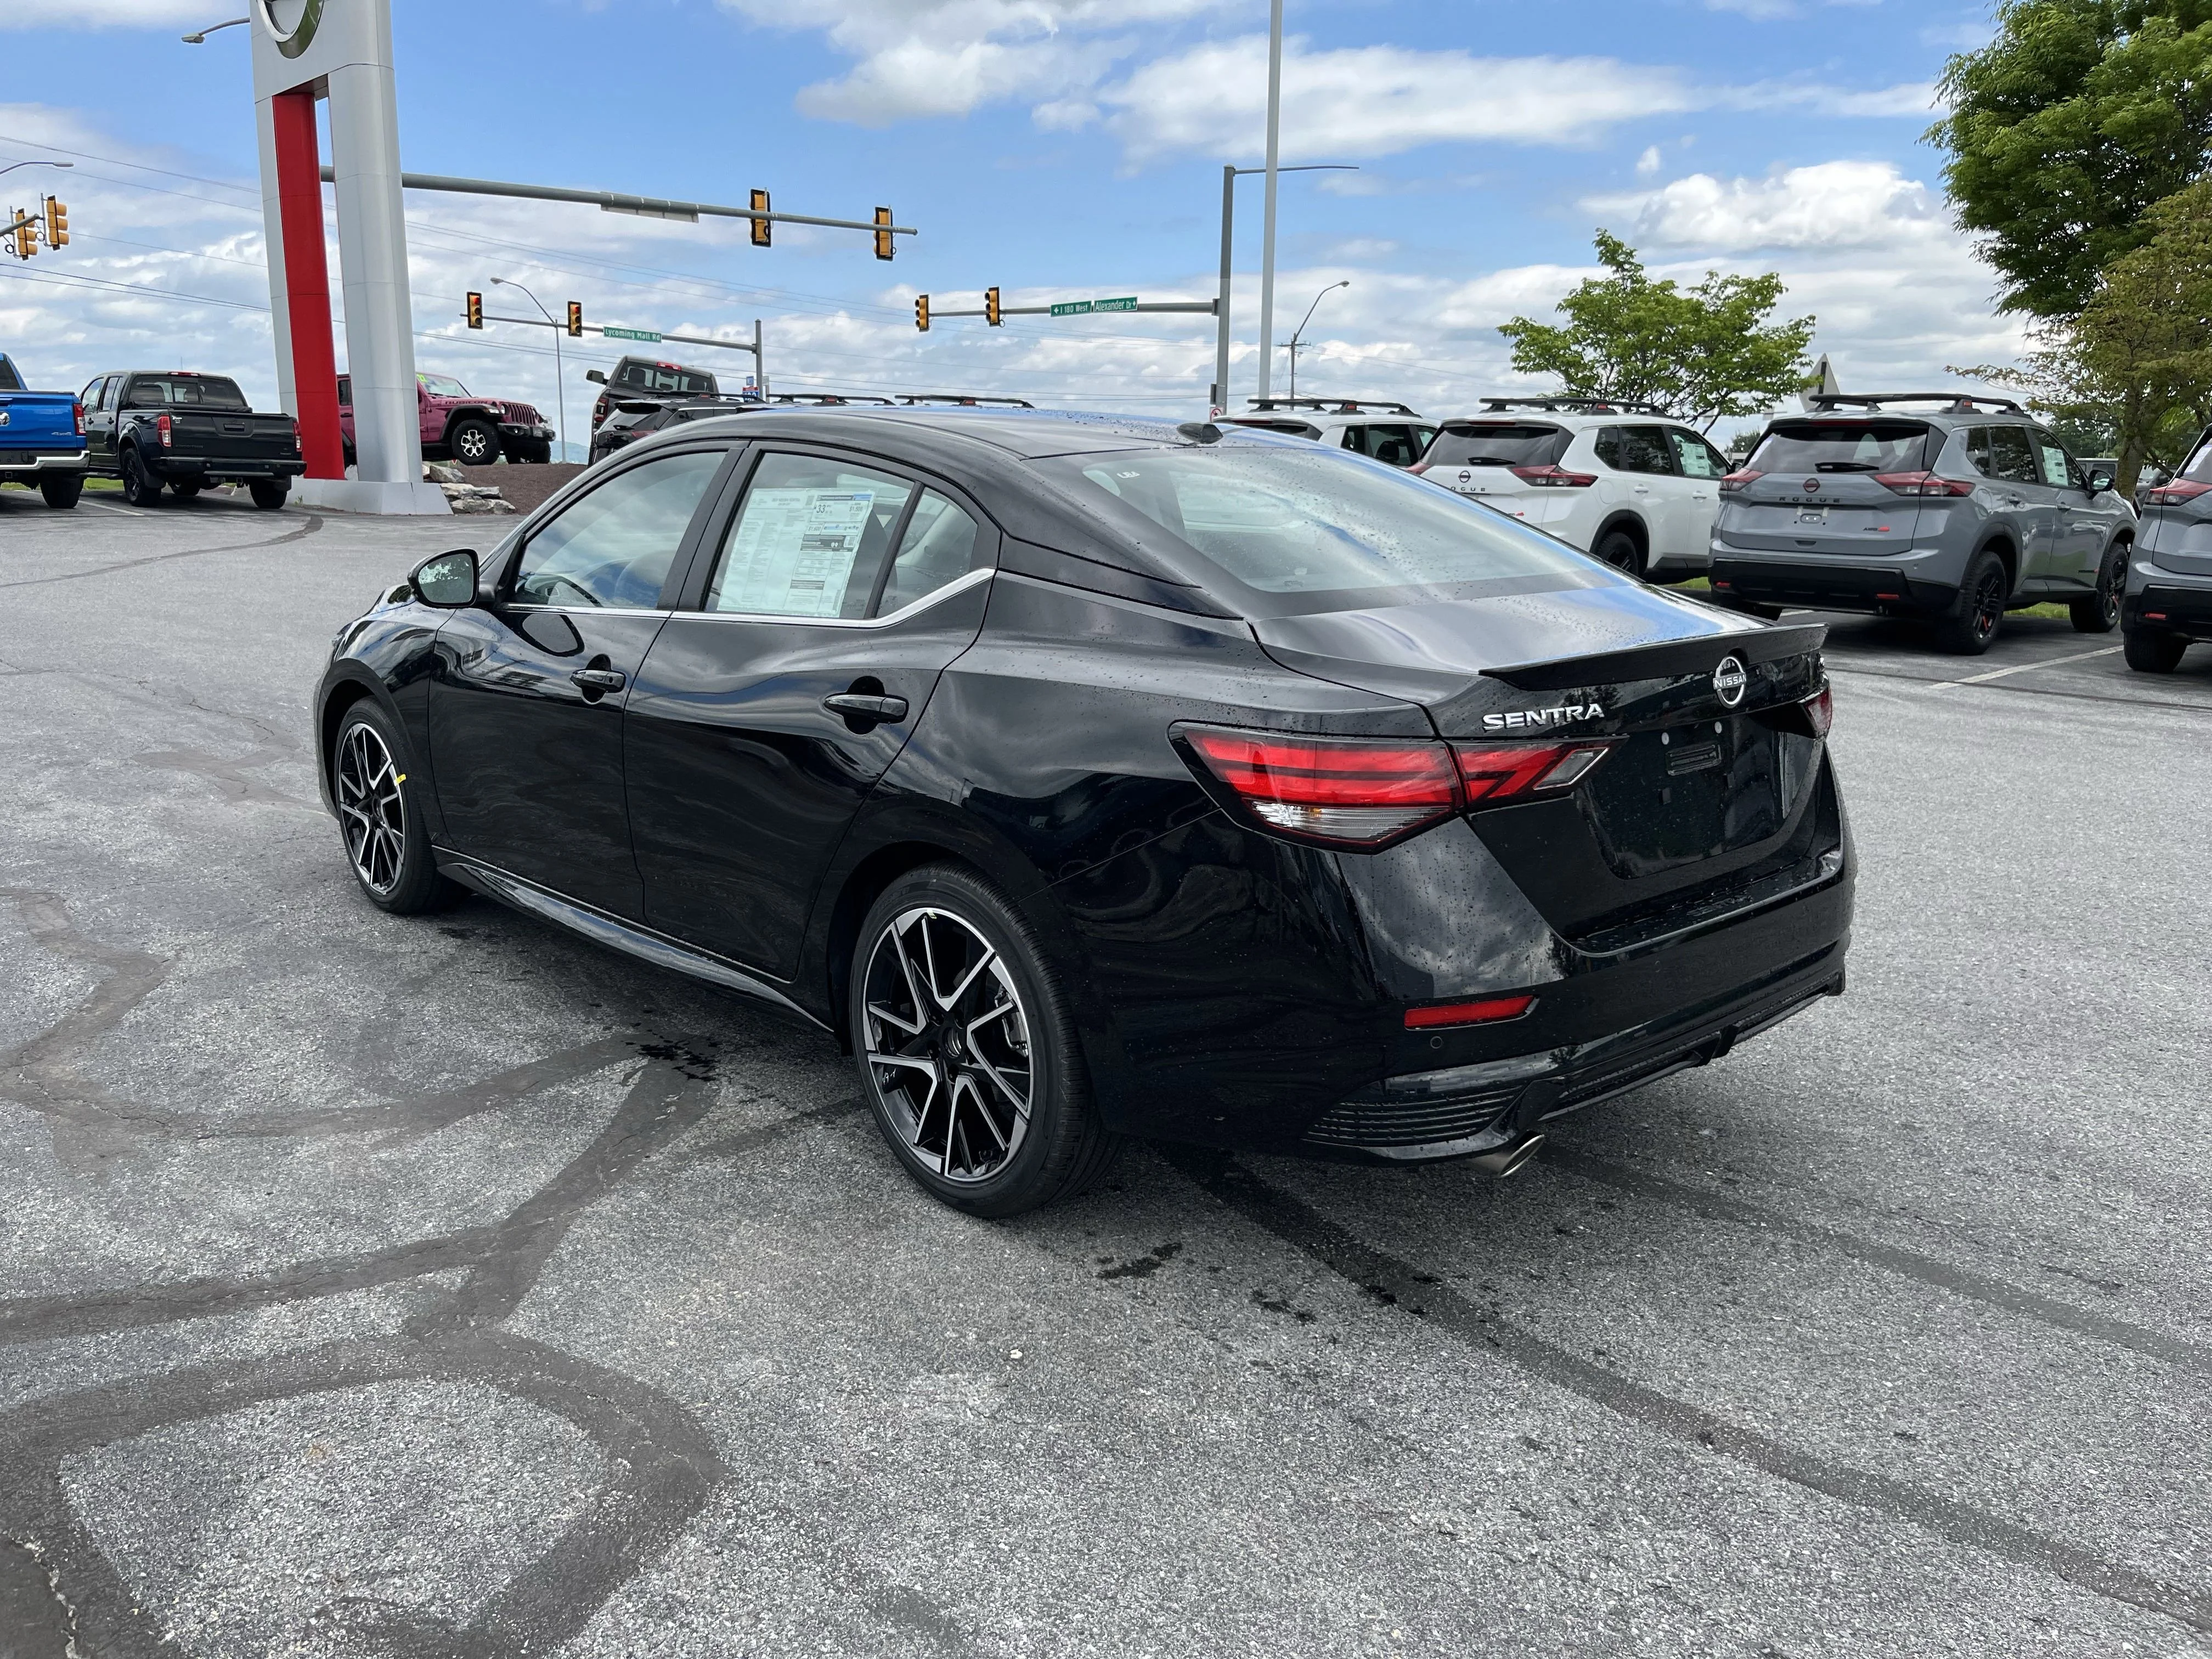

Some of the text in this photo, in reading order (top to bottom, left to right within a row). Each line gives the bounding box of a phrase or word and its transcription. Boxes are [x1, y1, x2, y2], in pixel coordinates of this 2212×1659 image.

[1064, 305, 1074, 313] 180
[1075, 304, 1088, 312] West
[1095, 301, 1124, 312] Alexander
[606, 329, 635, 339] Lycoming
[816, 505, 826, 513] 33
[1714, 675, 1746, 688] NISSAN
[1483, 703, 1605, 730] SENTRA
